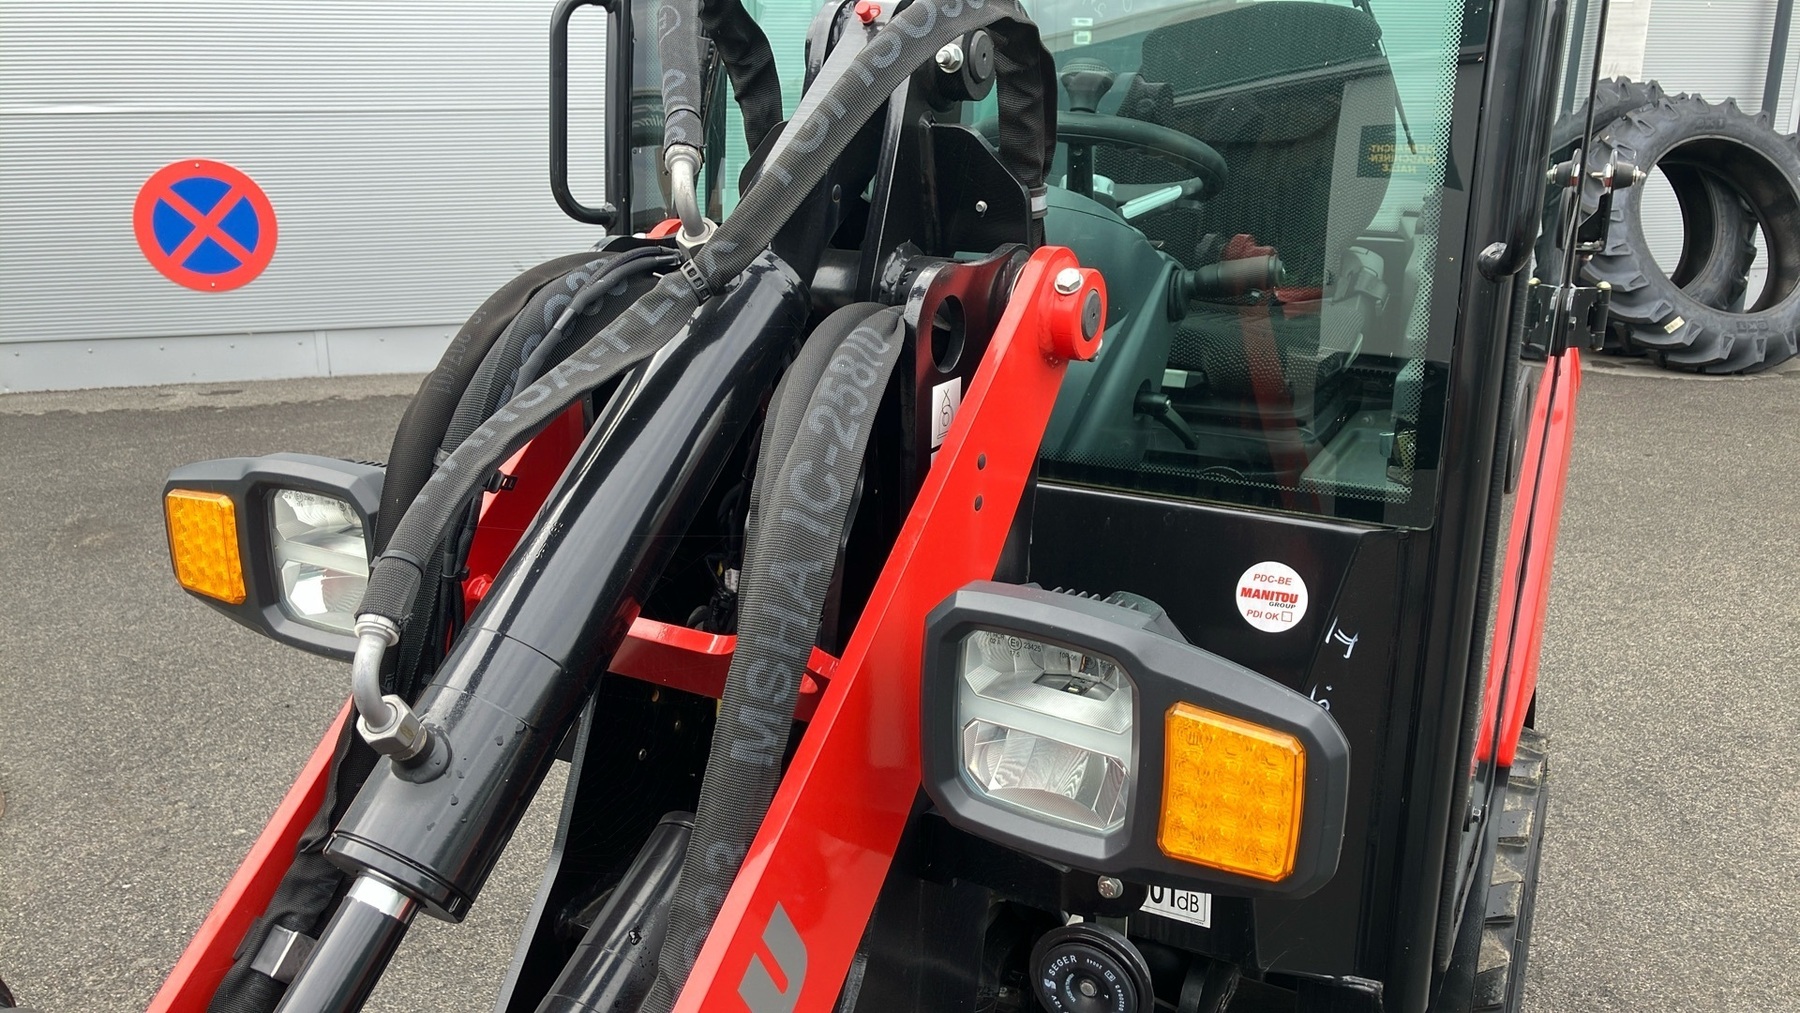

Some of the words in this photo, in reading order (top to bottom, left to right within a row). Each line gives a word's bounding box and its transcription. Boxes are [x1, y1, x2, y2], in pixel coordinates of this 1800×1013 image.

[1253, 573, 1292, 586] PDC-BE
[1240, 587, 1299, 604] MANITOU
[1269, 601, 1296, 610] GROUP
[1246, 609, 1264, 619] PDI
[1265, 611, 1280, 621] OK
[730, 560, 823, 766] MSHA
[737, 900, 808, 1013] U
[1048, 954, 1077, 976] SEGER
